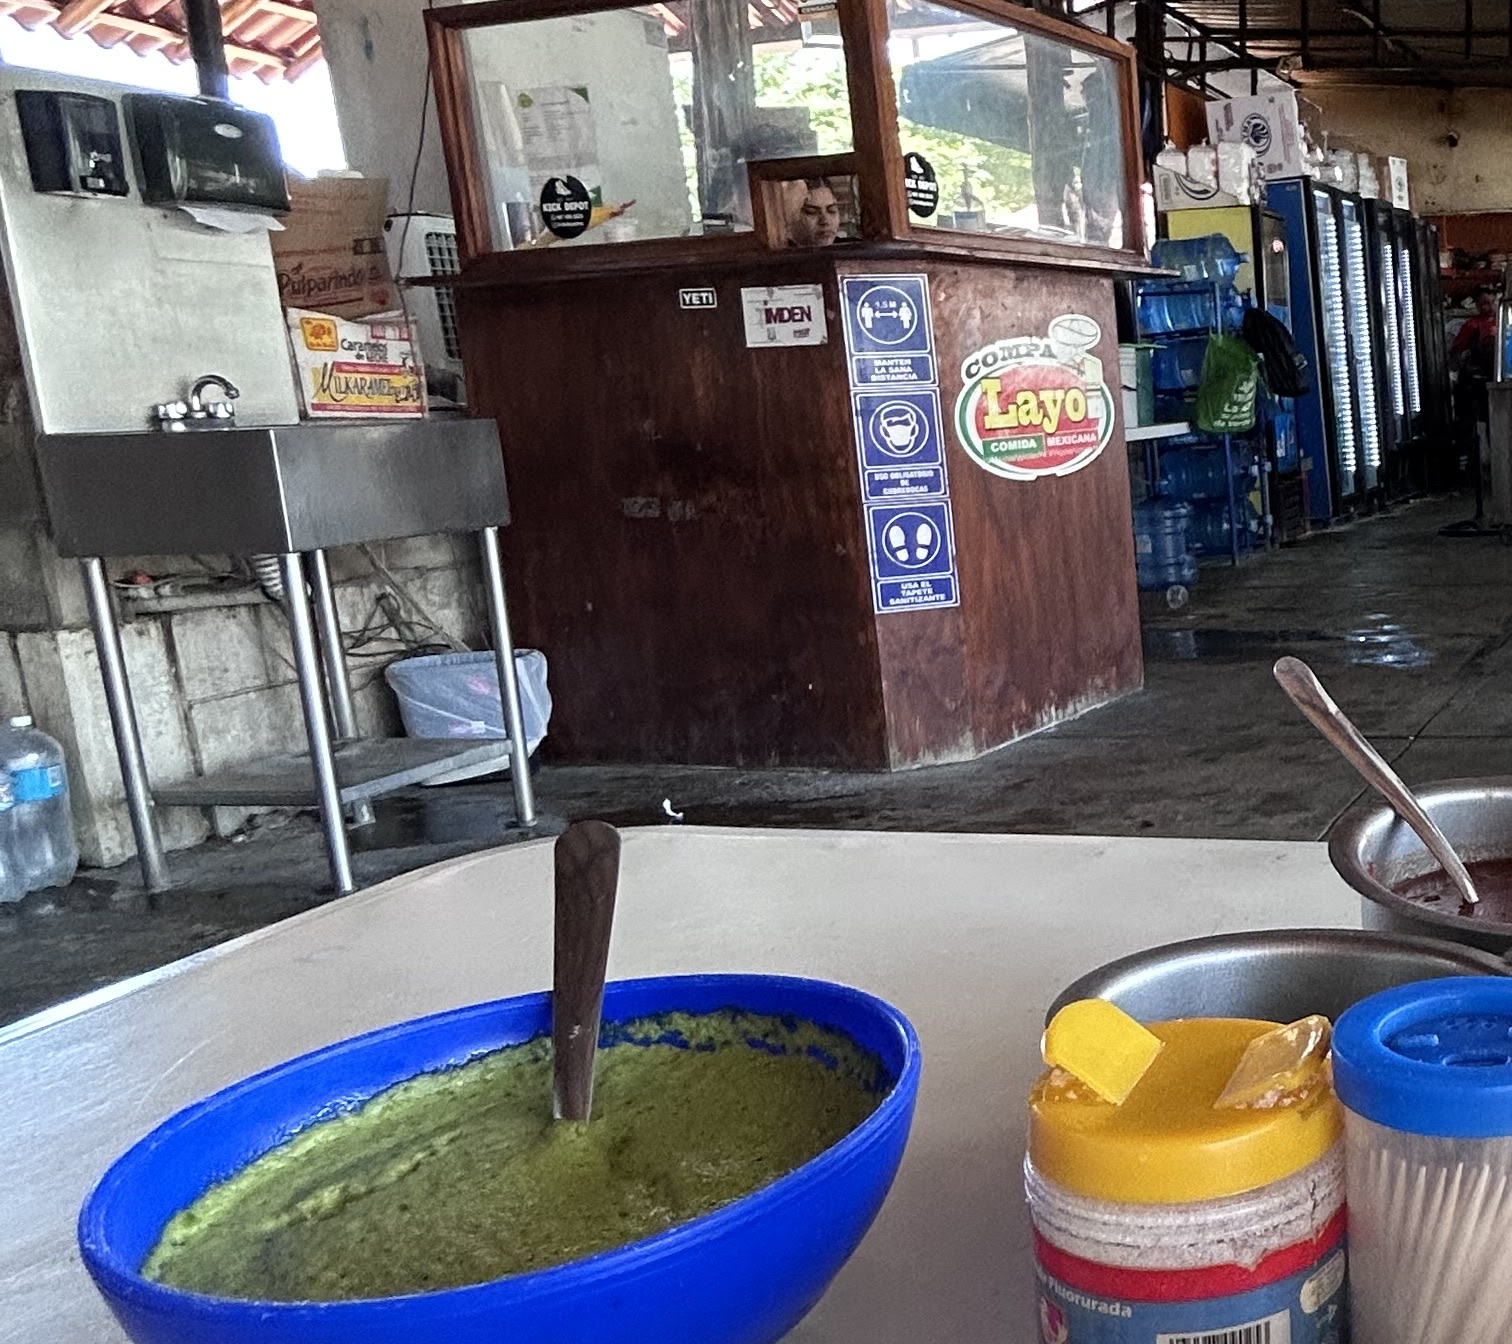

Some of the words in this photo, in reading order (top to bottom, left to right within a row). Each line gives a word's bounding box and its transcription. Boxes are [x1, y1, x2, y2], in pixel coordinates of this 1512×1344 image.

[682, 292, 713, 305] YETI
[873, 358, 912, 367] MANTEN
[965, 343, 1058, 379] COMPA
[874, 366, 887, 374] LA
[870, 372, 918, 382] DISTANCIA
[980, 378, 1087, 434] Layo
[990, 438, 1037, 453] COMIDA
[1047, 432, 1097, 447] MEXICANA
[901, 581, 919, 590] USA
[920, 580, 932, 588] EL
[901, 587, 933, 597] TAPETE
[889, 593, 947, 606] SANITIZANTE
